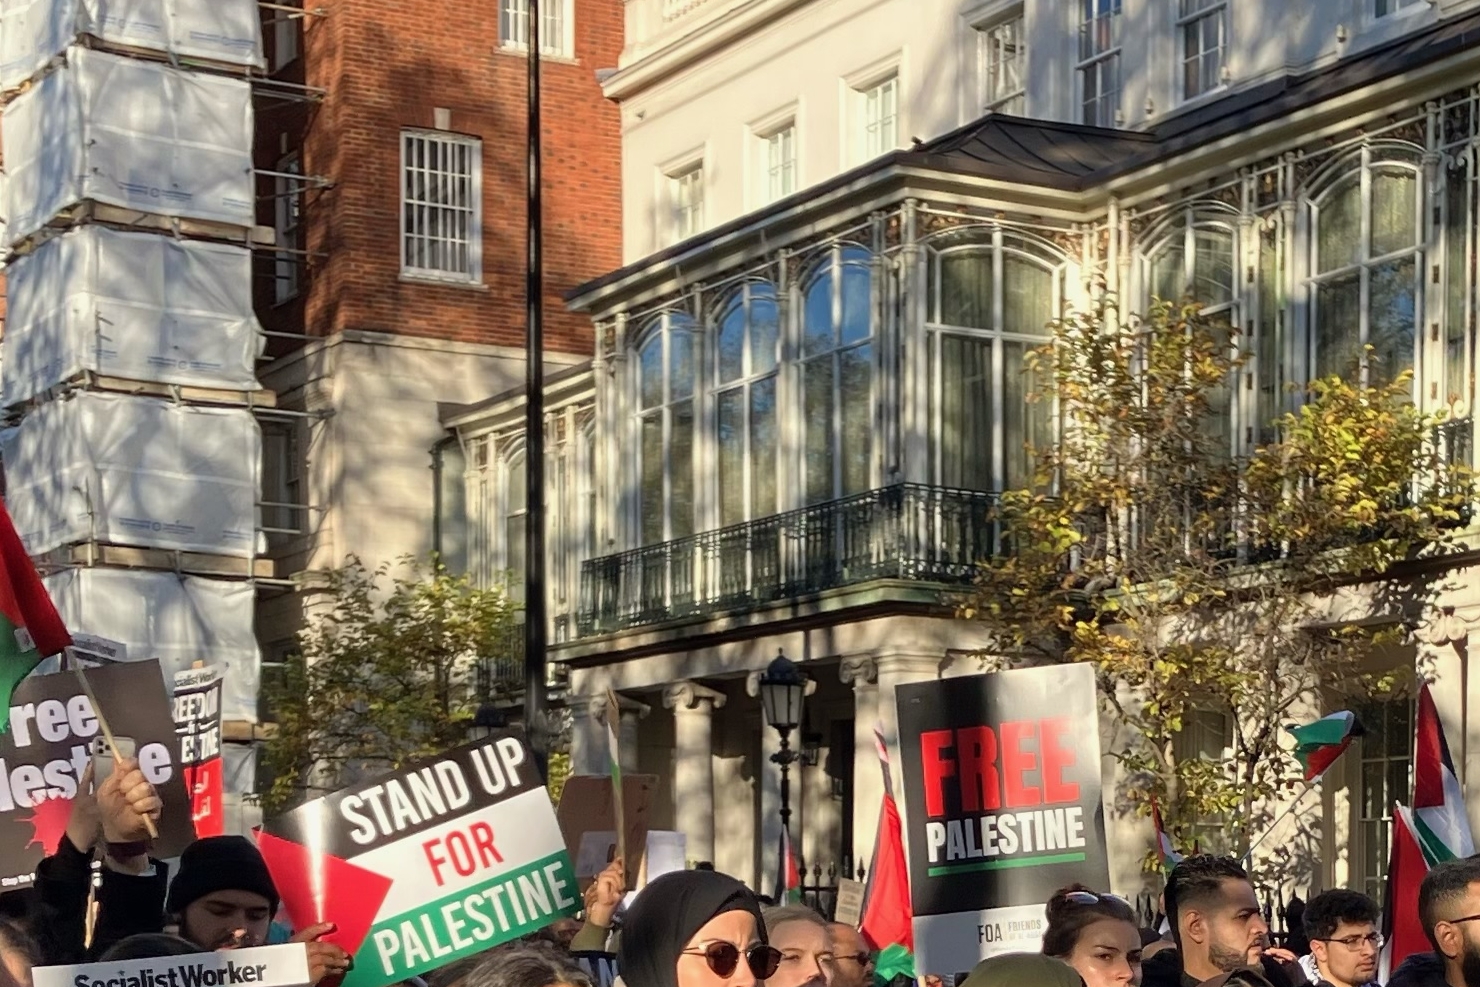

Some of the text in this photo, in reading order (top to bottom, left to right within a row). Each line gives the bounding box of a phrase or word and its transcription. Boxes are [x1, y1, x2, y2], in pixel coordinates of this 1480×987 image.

[10, 694, 99, 748] ree
[340, 737, 525, 845] STAND UP
[920, 718, 1080, 817] FREE
[422, 821, 504, 887] FOR
[926, 806, 1086, 863] PALESTINE
[373, 861, 576, 976] PALESTINE
[977, 923, 1003, 945] FOA
